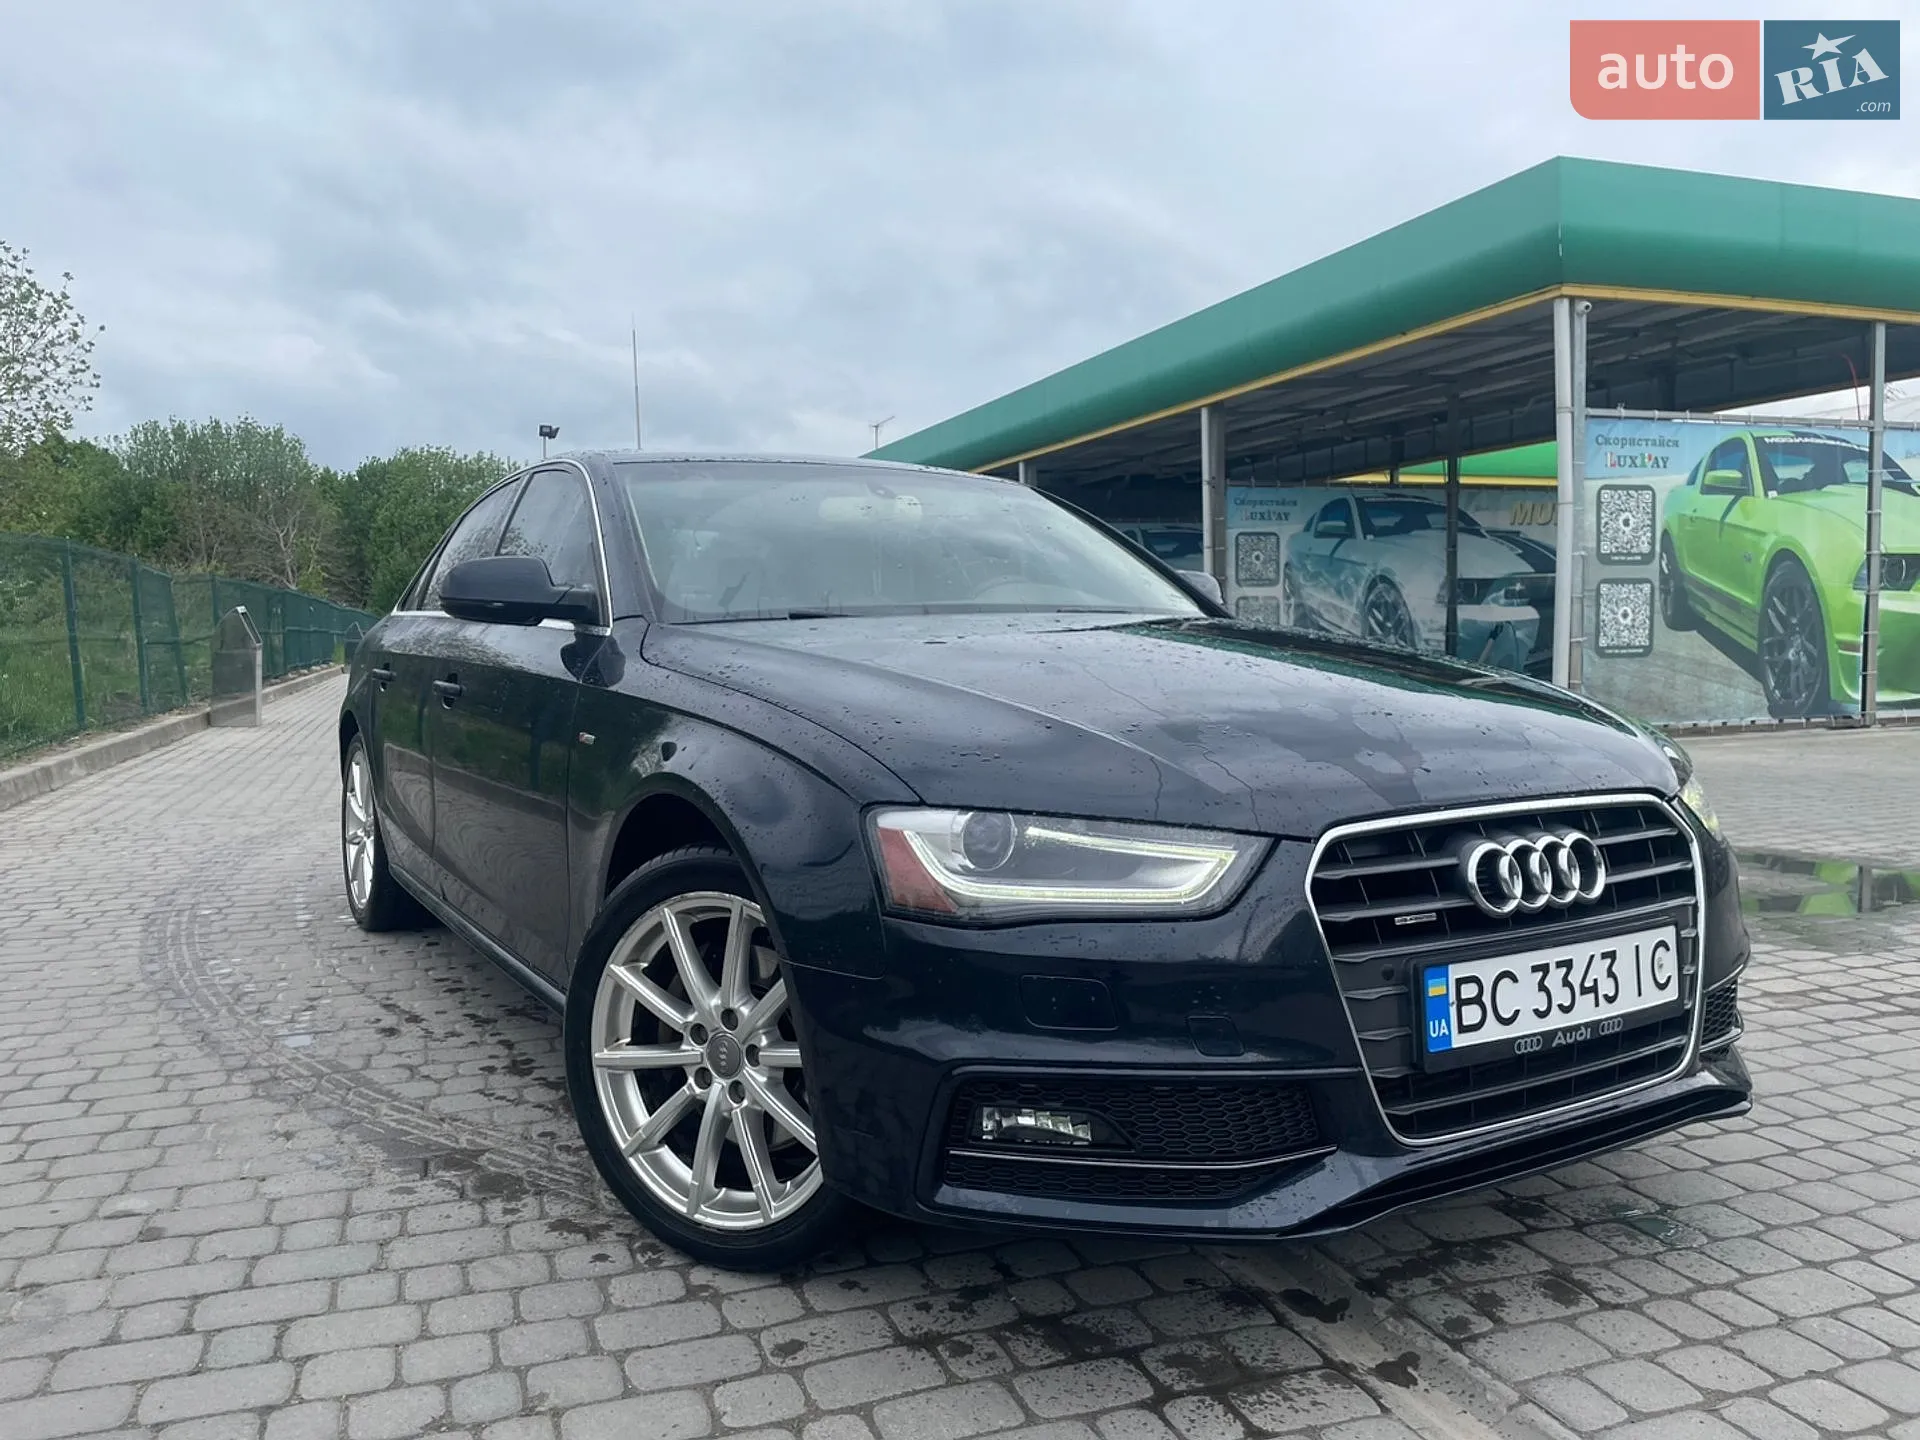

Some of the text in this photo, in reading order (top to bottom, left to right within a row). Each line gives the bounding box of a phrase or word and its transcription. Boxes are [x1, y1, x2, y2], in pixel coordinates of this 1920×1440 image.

[1595, 434, 1680, 448] Скористайся
[1510, 502, 1558, 526] MU
[1454, 939, 1672, 1035] BC 3343 IC
[1429, 1019, 1449, 1038] UA
[1552, 1026, 1591, 1047] Audi
